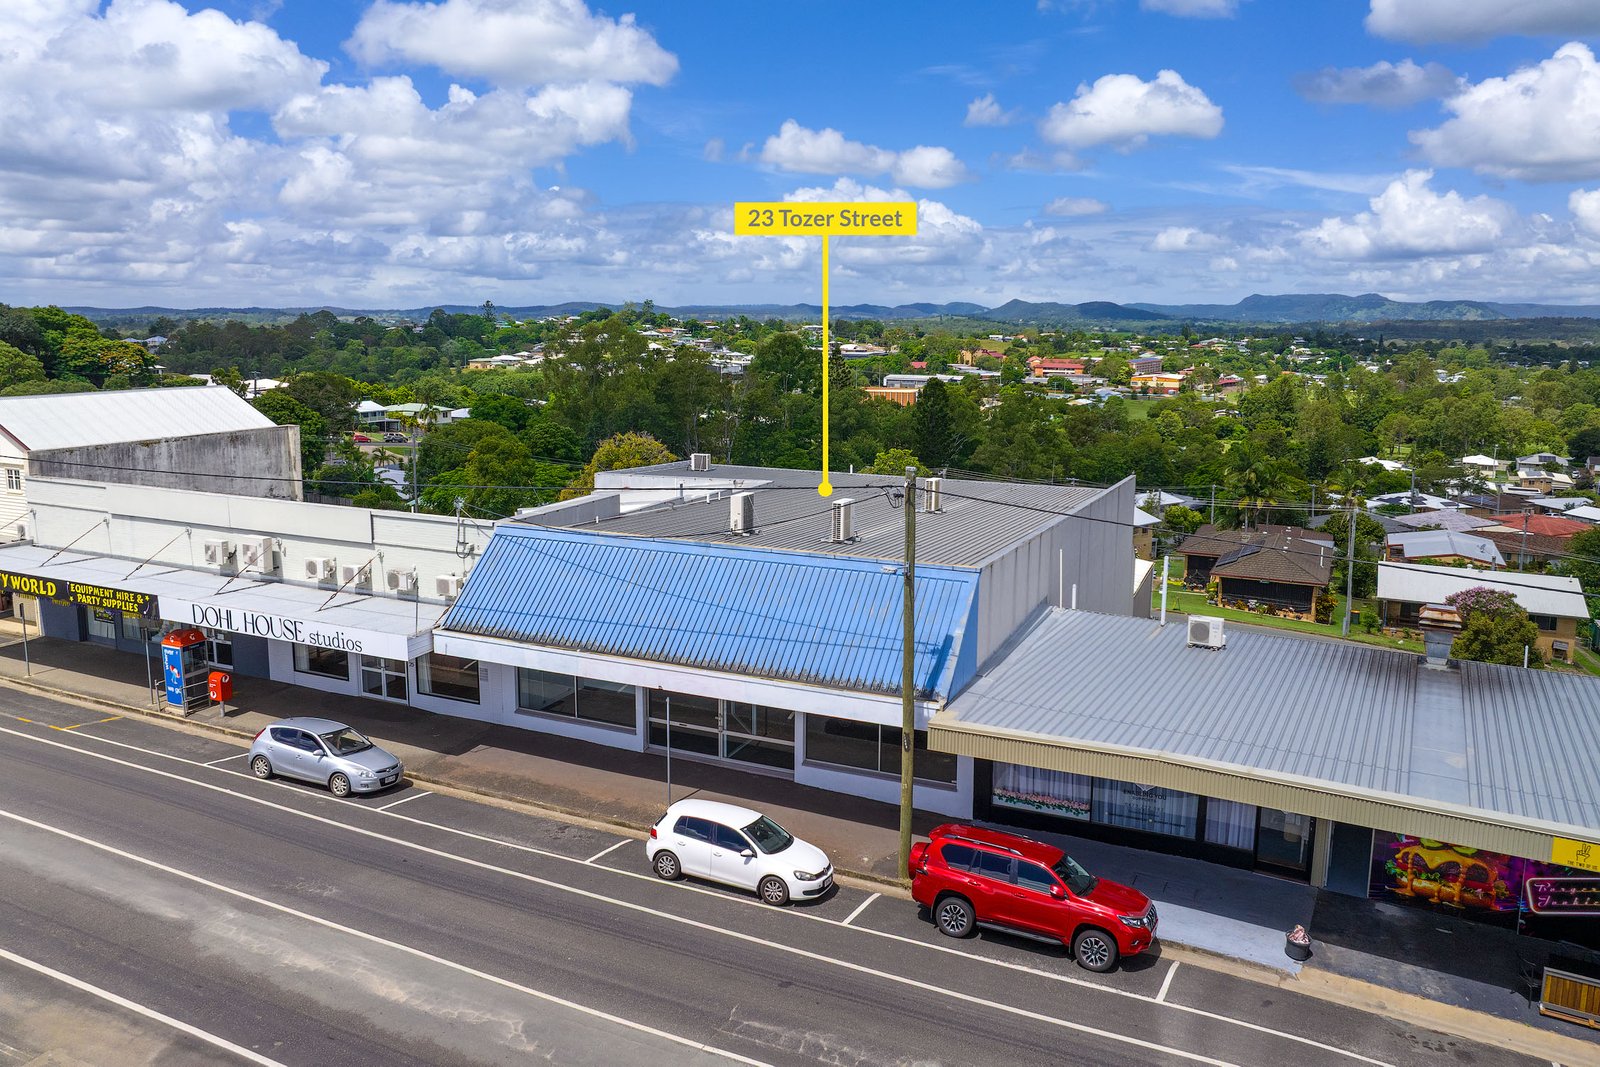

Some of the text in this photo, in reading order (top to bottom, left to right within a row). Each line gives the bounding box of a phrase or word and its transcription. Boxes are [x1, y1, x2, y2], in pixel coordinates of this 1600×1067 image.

[0, 573, 57, 597] Y WORLD
[70, 583, 144, 604] EQUIPMENT HIRE &
[77, 594, 139, 612] PARTY SUPPLIES
[192, 603, 363, 653] DOHL HOUSE studios
[1154, 792, 1167, 801] YOU
